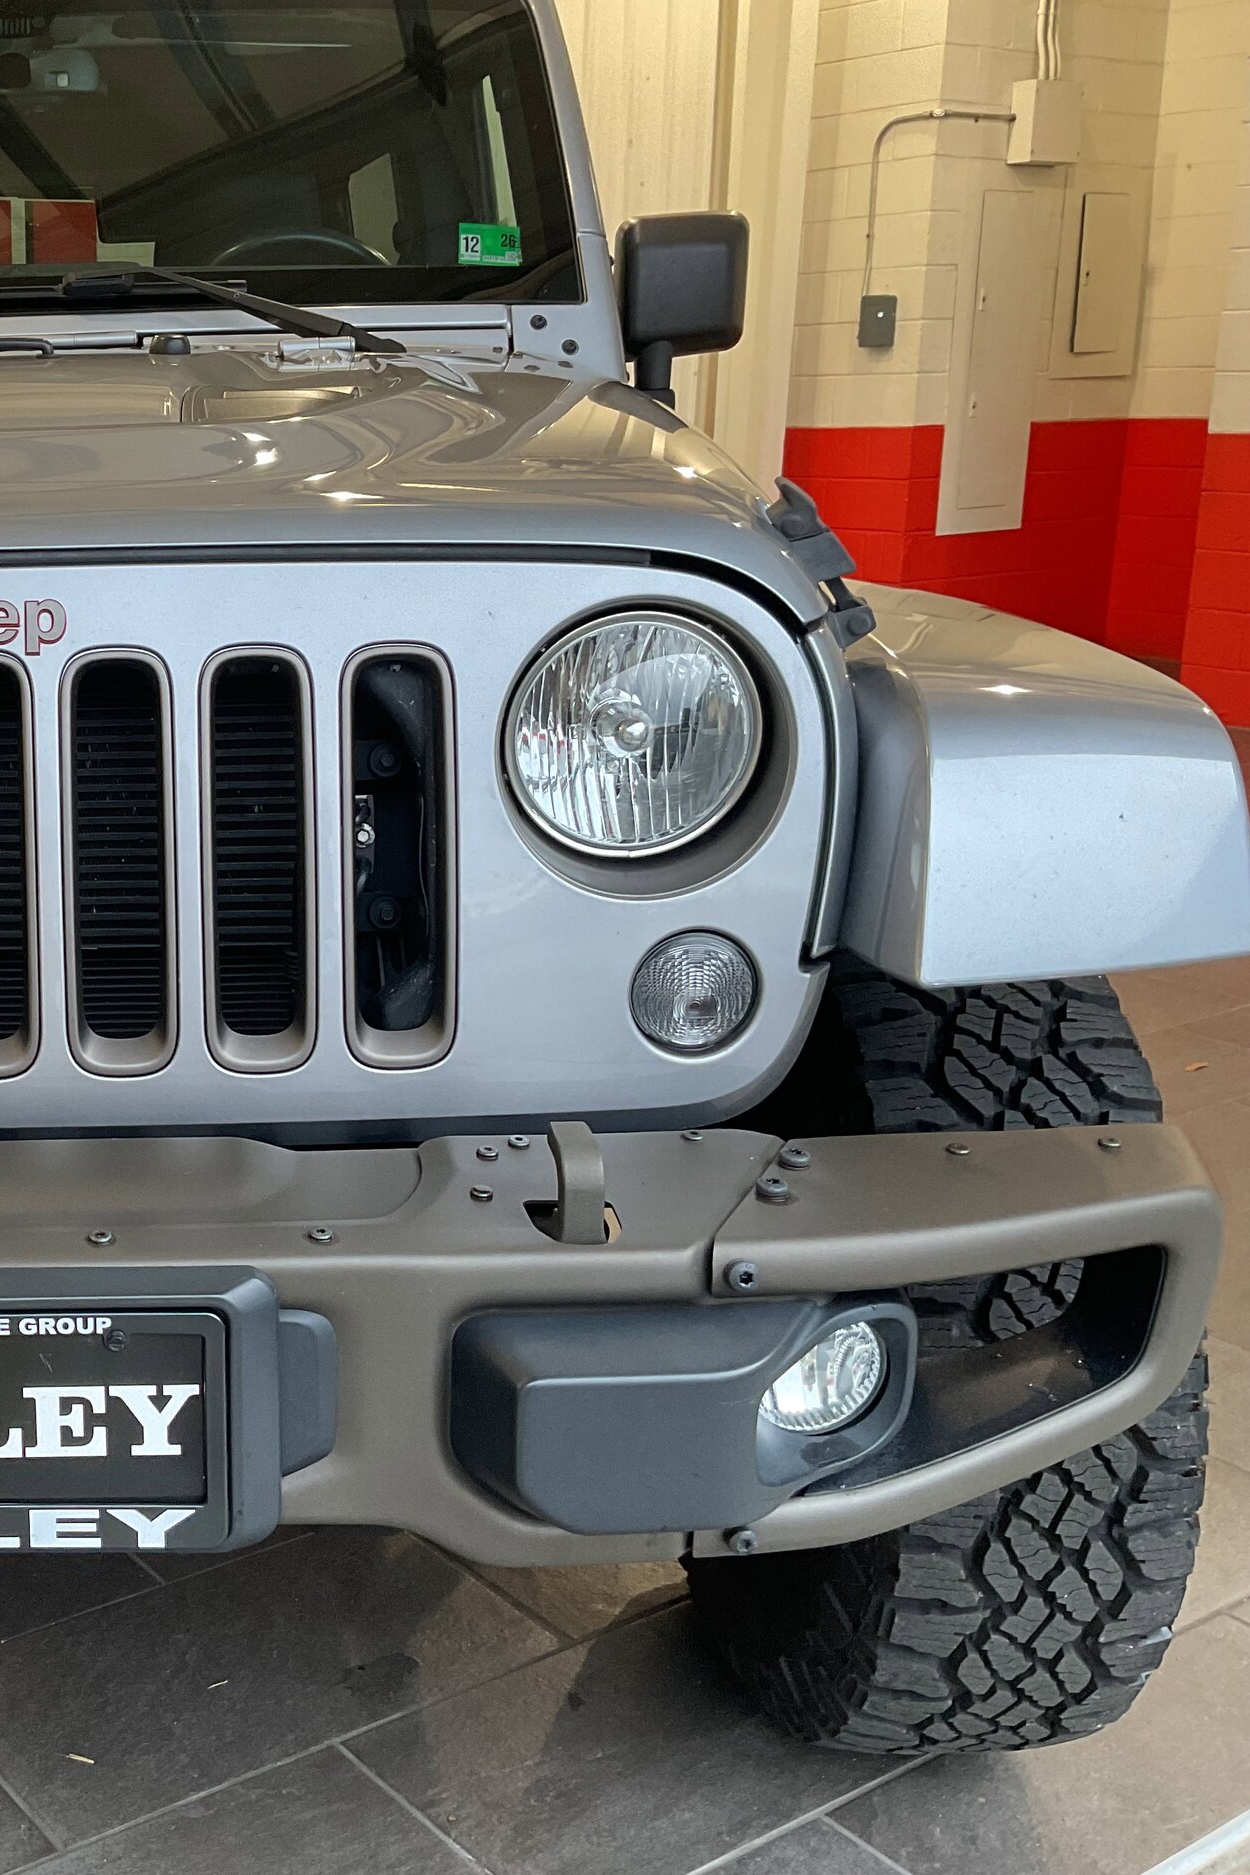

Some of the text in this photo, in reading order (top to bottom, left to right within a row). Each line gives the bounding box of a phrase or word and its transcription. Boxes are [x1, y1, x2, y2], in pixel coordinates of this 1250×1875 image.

[462, 234, 517, 253] 12 26
[18, 1317, 112, 1336] GROUP
